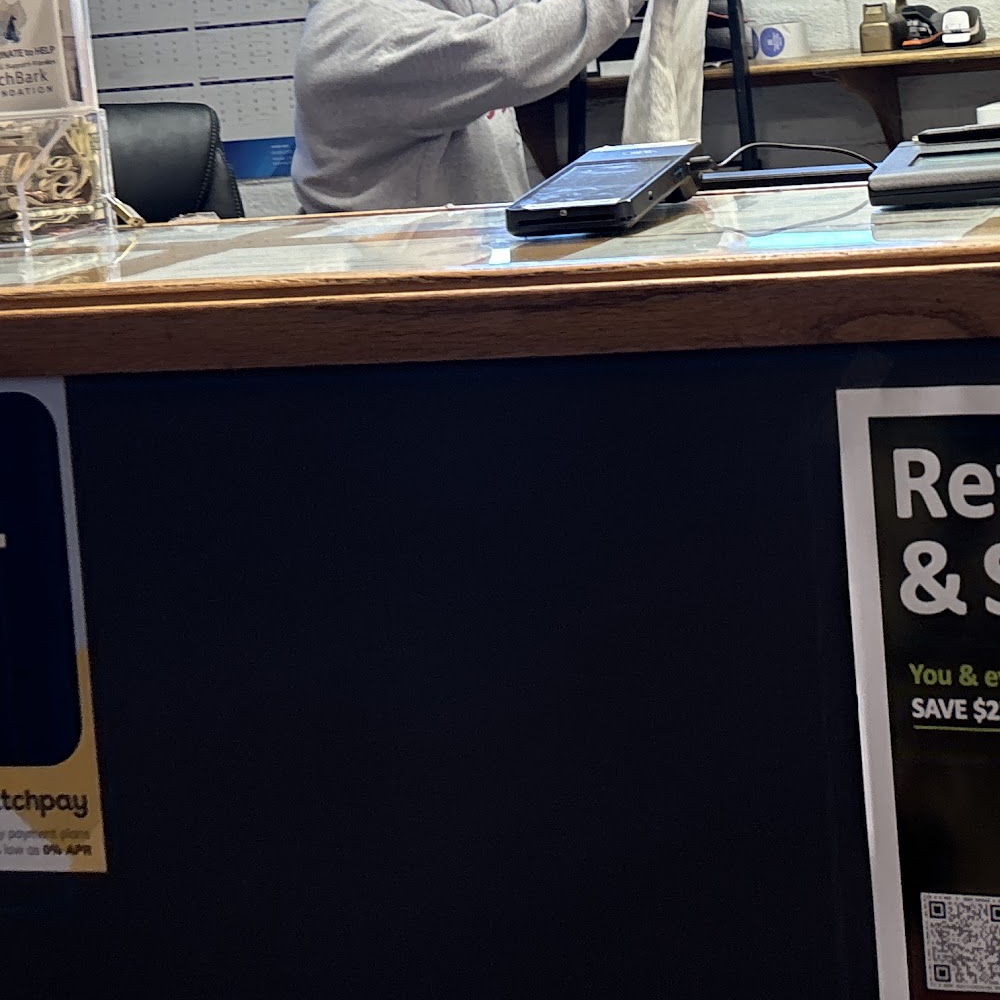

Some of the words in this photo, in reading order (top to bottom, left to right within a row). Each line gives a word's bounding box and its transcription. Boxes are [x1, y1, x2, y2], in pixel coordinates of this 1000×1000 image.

[899, 540, 968, 616] &
[909, 663, 952, 687] You
[958, 664, 979, 688] &
[911, 697, 968, 721] SAVE
[0, 788, 89, 818] tchpay
